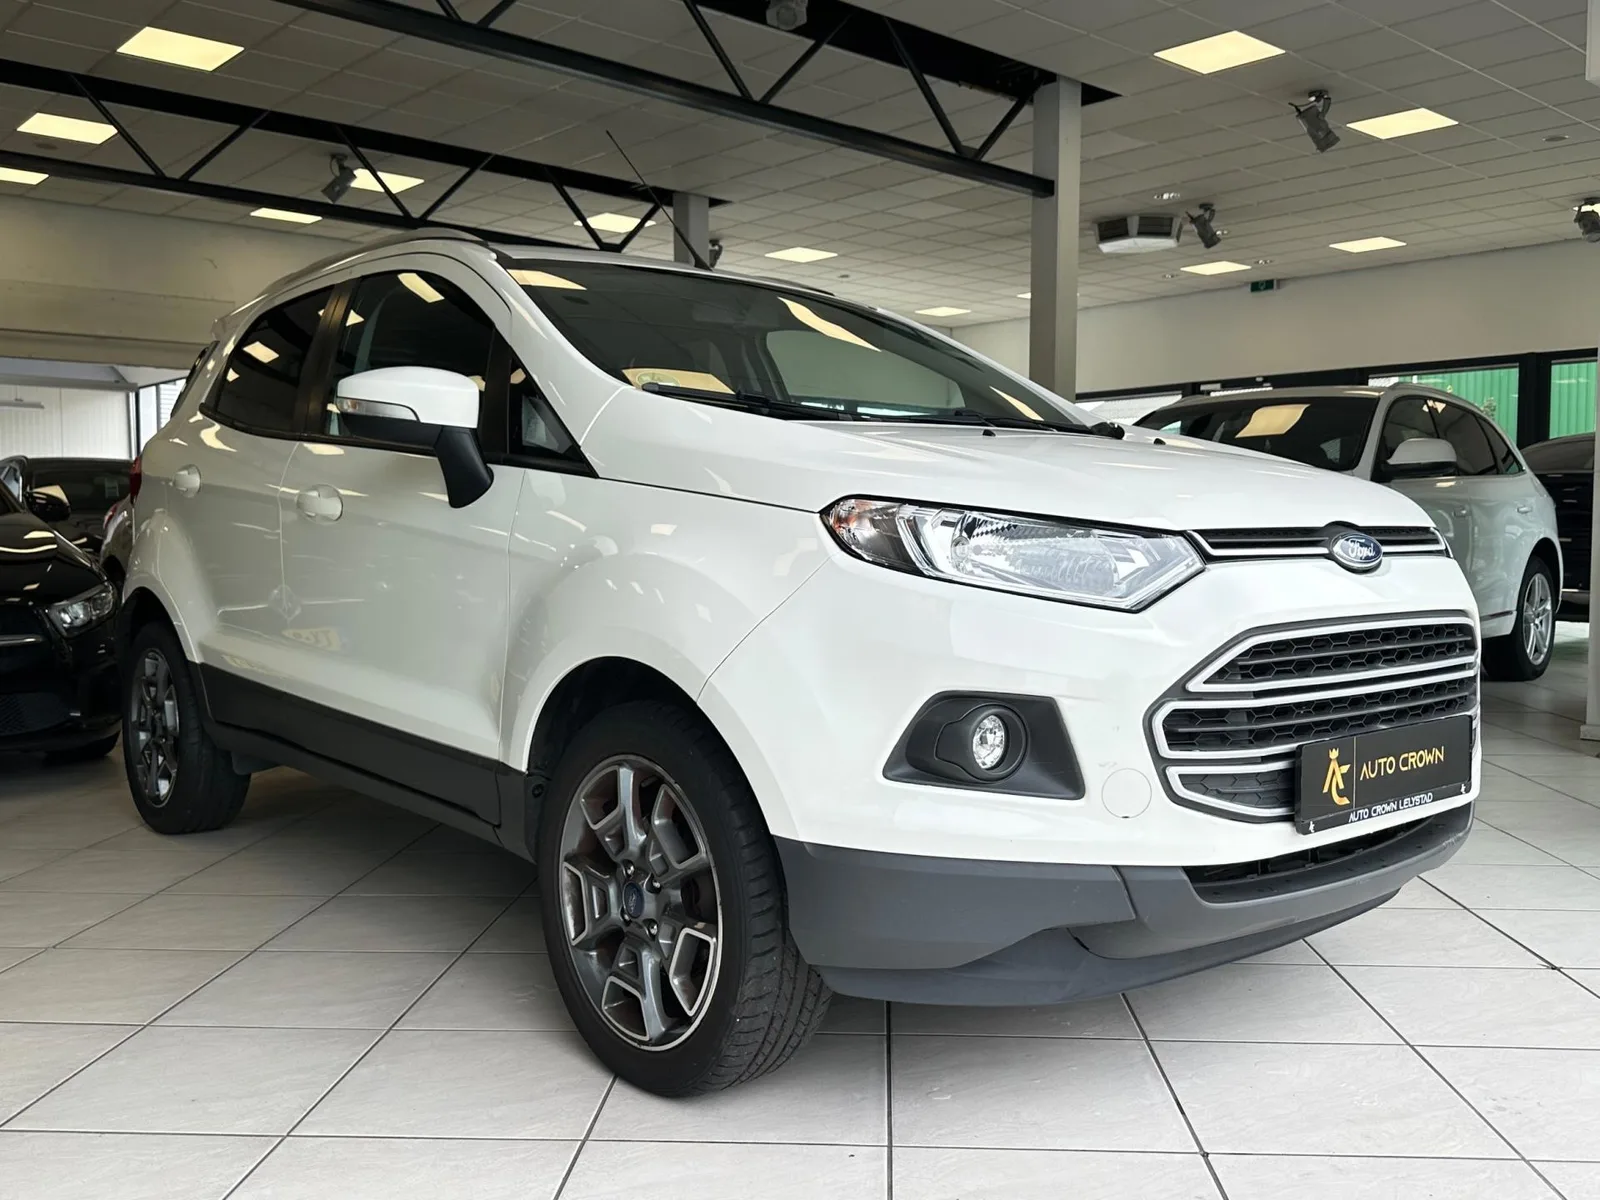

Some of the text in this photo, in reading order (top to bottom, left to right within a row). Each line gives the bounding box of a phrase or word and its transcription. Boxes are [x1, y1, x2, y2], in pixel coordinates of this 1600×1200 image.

[1348, 538, 1376, 560] Ford
[1360, 746, 1445, 781] AUTO CROWN
[1349, 792, 1434, 823] AUTO CROWN LELYSTAD
